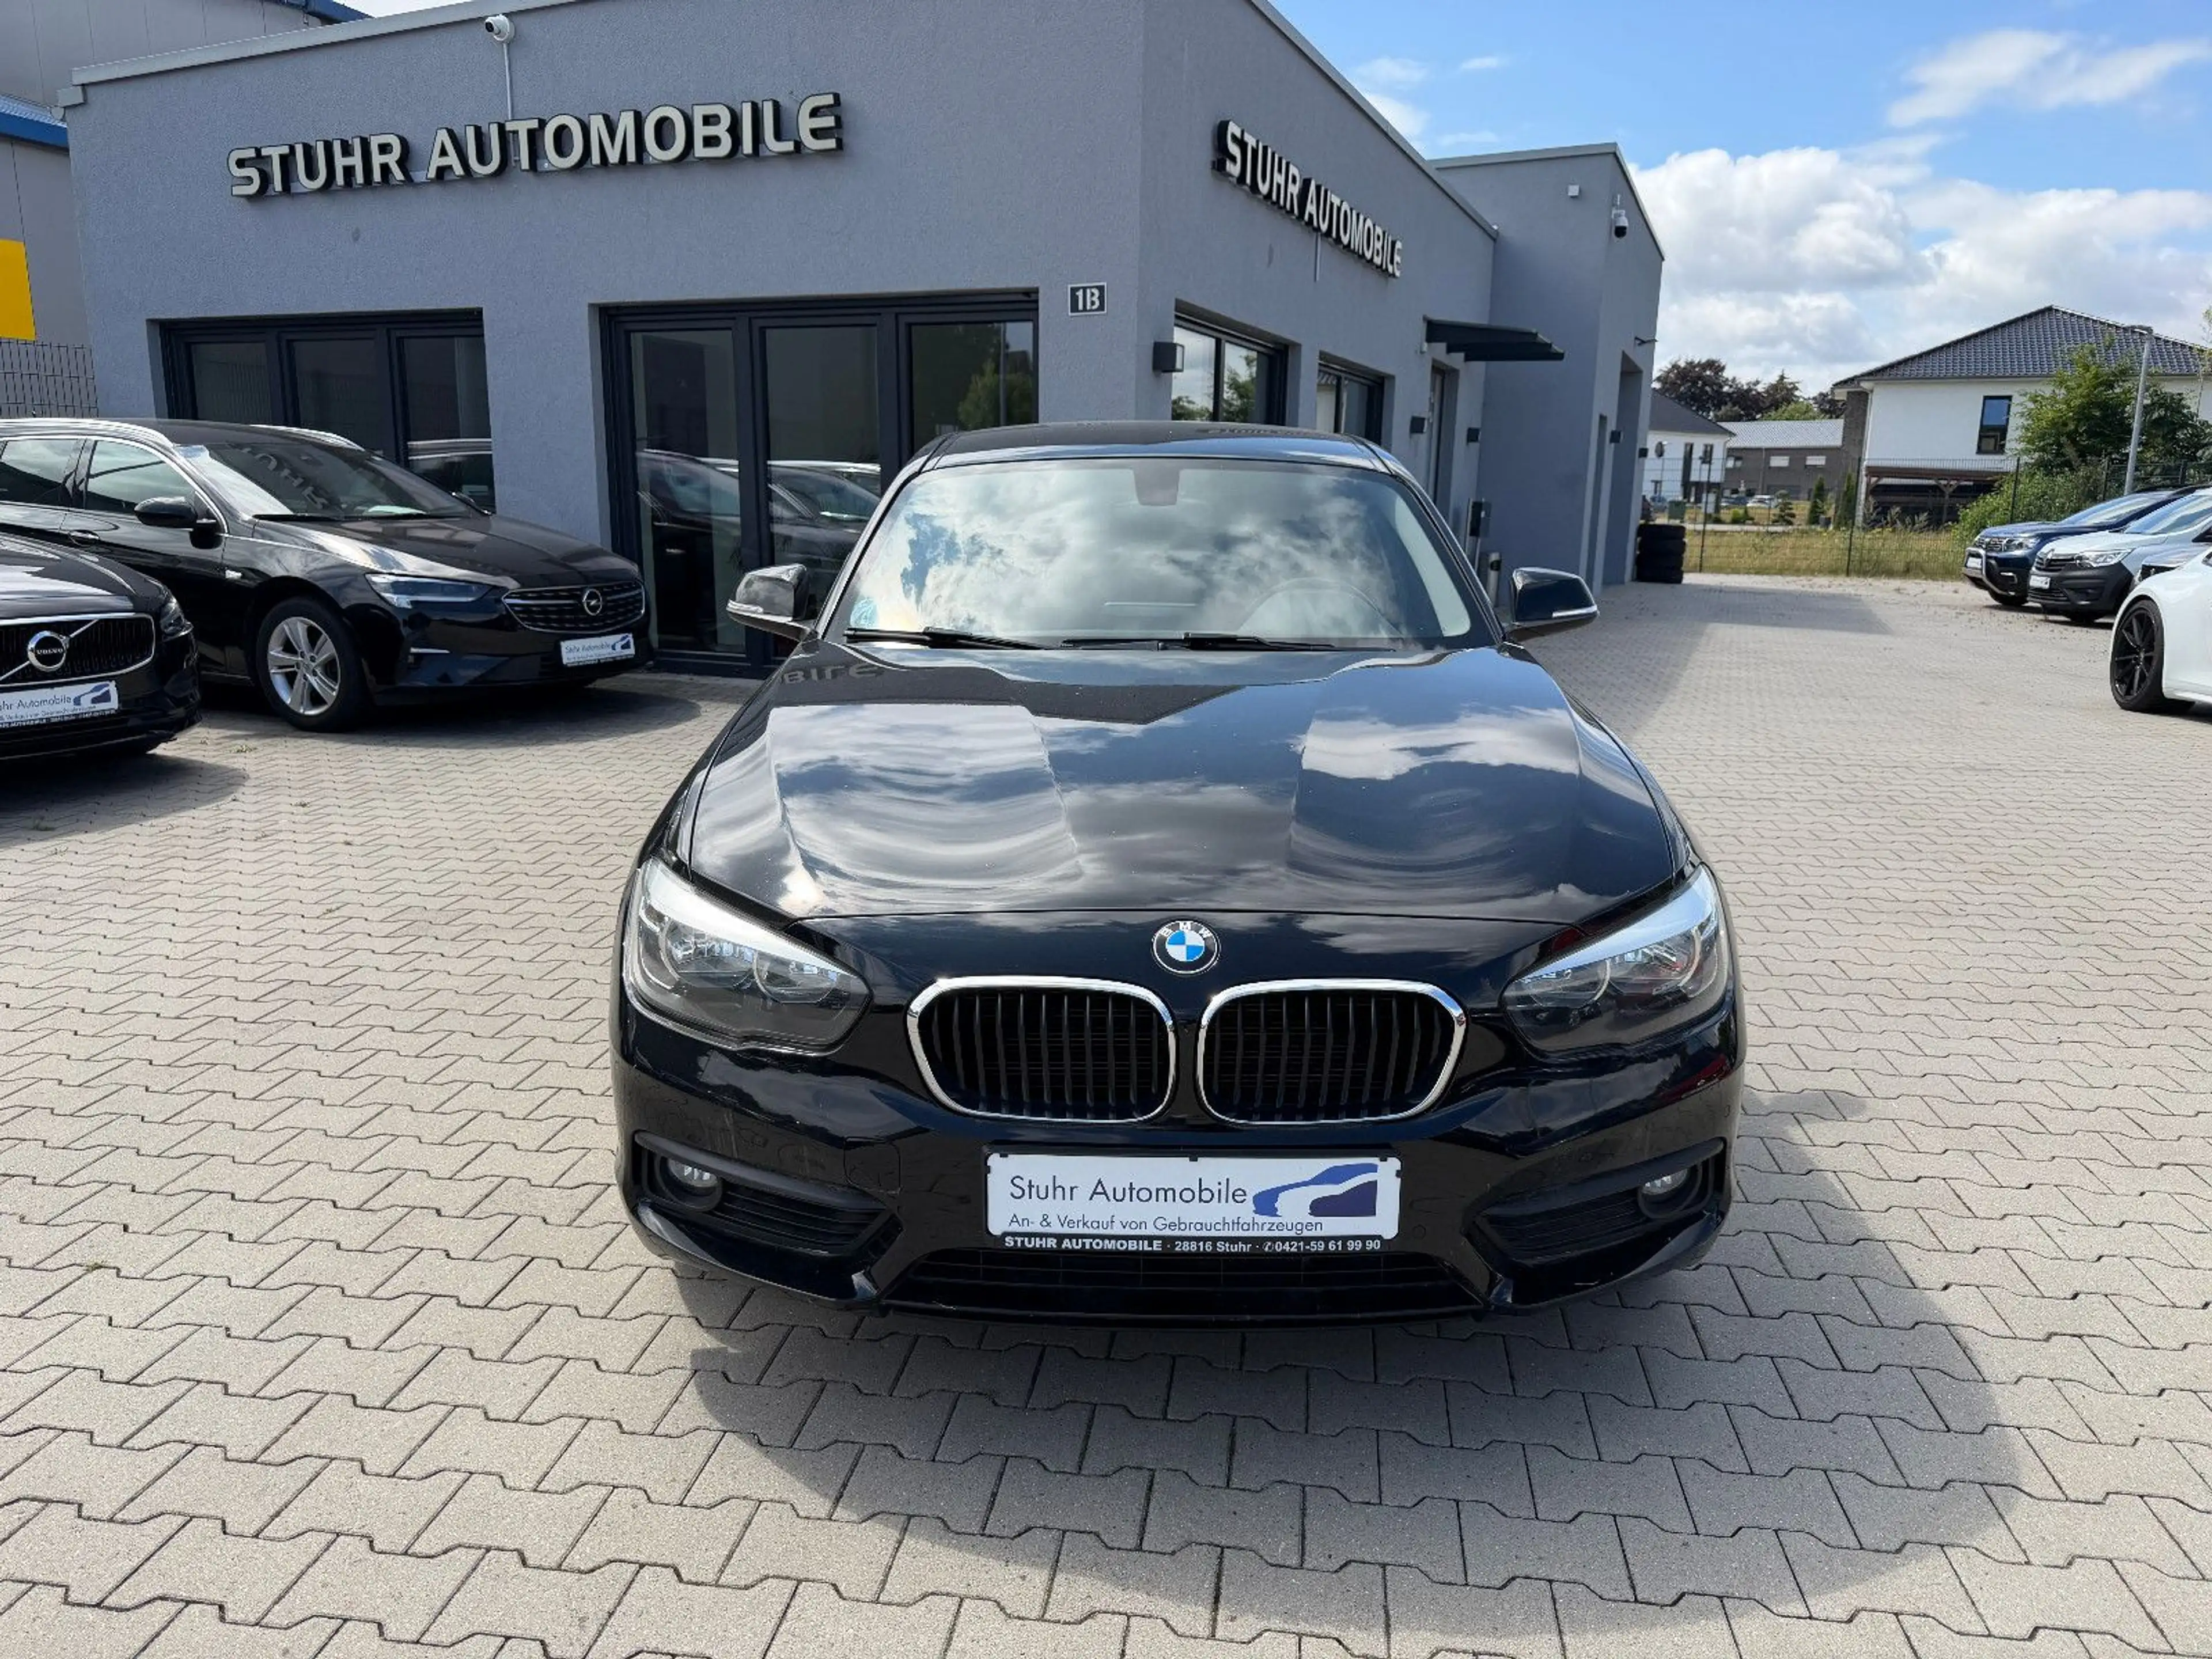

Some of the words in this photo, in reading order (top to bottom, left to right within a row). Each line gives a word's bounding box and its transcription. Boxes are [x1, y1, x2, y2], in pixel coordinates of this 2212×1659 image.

[228, 132, 410, 196] STUHR
[426, 92, 842, 181] AUTOMOBILE
[1219, 120, 1300, 217] STUHR
[1303, 177, 1403, 278] AUTOMOBILE
[1075, 287, 1100, 310] 1B
[1010, 1175, 1078, 1200] Stuhr
[1089, 1177, 1247, 1203] Automobile
[1009, 1213, 1035, 1228] An-
[1040, 1214, 1052, 1228] &
[1058, 1214, 1115, 1230] Verkauf
[1120, 1222, 1147, 1230] von
[1153, 1216, 1323, 1236] Gebrauchtfahrzeugen
[1005, 1236, 1057, 1249] STUHR
[1062, 1238, 1162, 1251] AUTOMOBILE
[1175, 1241, 1213, 1252] 28816
[1217, 1241, 1252, 1252] Stuhr
[1328, 1240, 1343, 1251] 61
[1347, 1240, 1362, 1251] 99
[1366, 1239, 1381, 1250] 90
